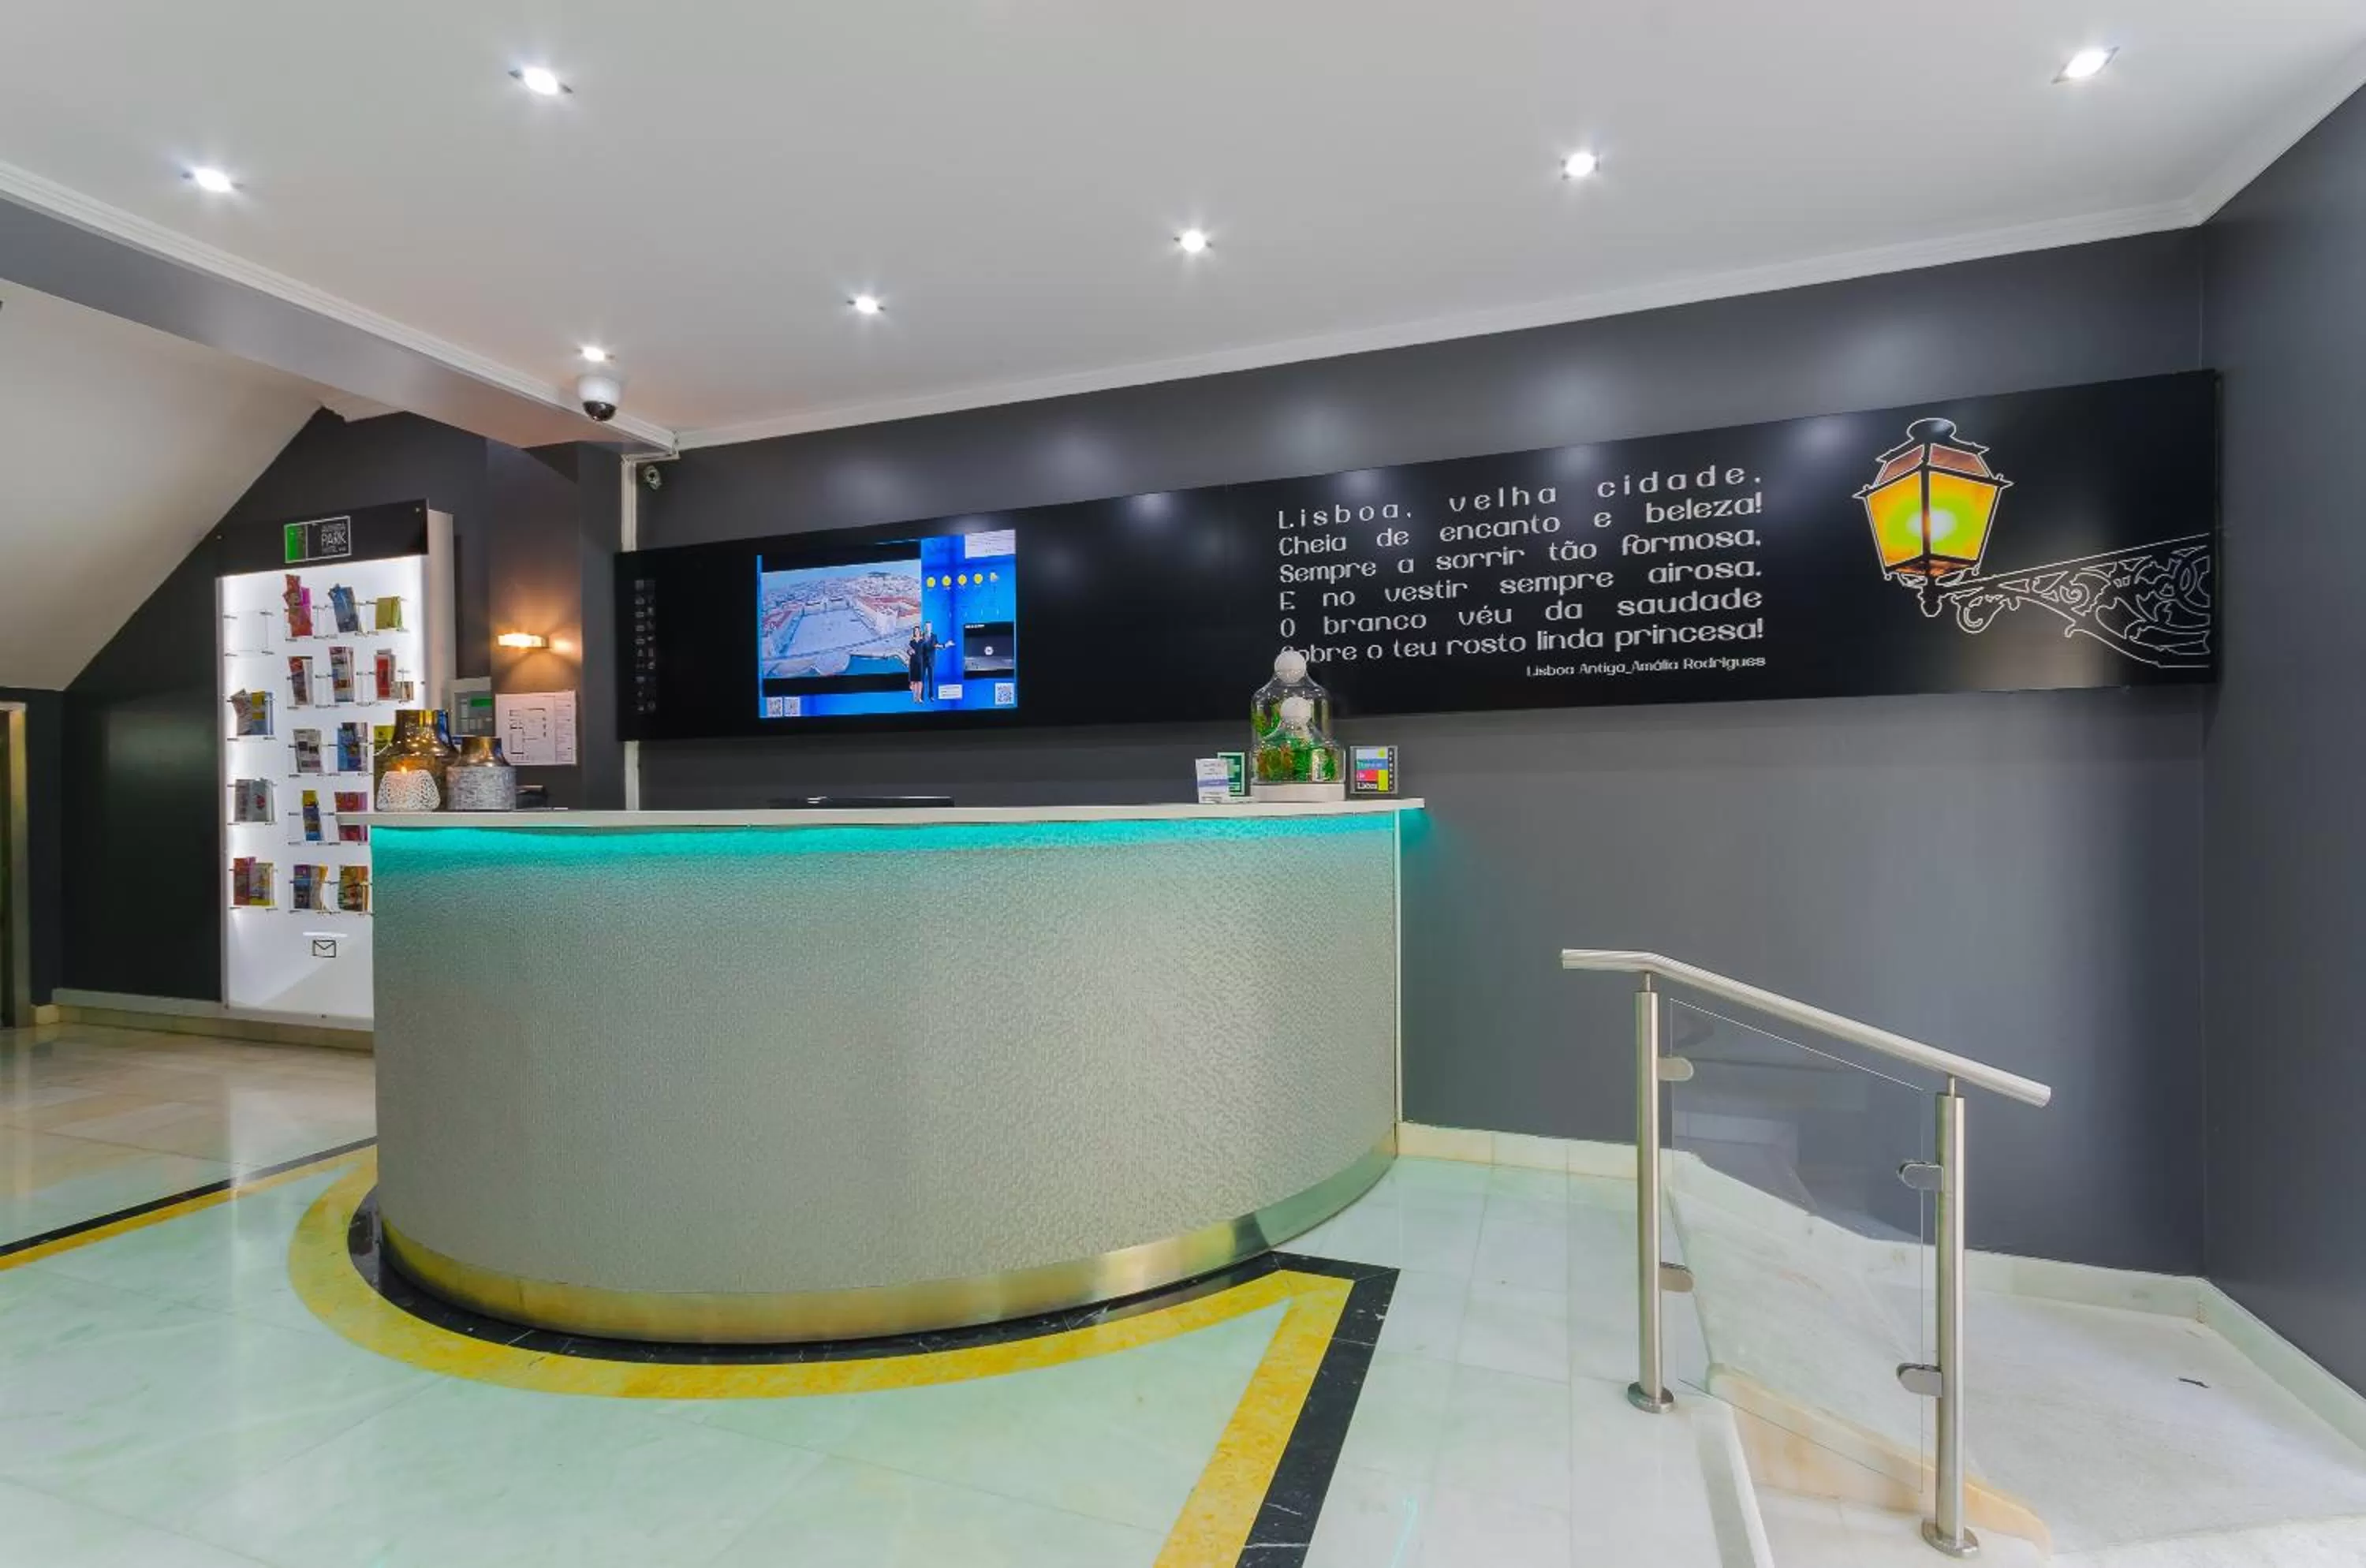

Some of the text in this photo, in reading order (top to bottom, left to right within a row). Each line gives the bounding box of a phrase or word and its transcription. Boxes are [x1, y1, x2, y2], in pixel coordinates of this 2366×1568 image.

[1450, 487, 1556, 512] velha
[1279, 492, 1762, 556] Cheia de encanto e beleza!
[1279, 558, 1376, 584] Sempre
[1398, 558, 1414, 573] a
[1436, 547, 1525, 570] sorrir
[1549, 540, 1597, 561] tão
[1279, 591, 1296, 611] E
[1323, 591, 1356, 607] no
[1385, 580, 1468, 603] vestir
[1500, 572, 1614, 595] sempre
[1280, 588, 1763, 638] O branco véu da saudade
[1281, 618, 1763, 663] obre o teu rosto linda princesa!
[1527, 665, 1575, 677] Lisboa
[1683, 656, 1767, 671] Rodrigues
